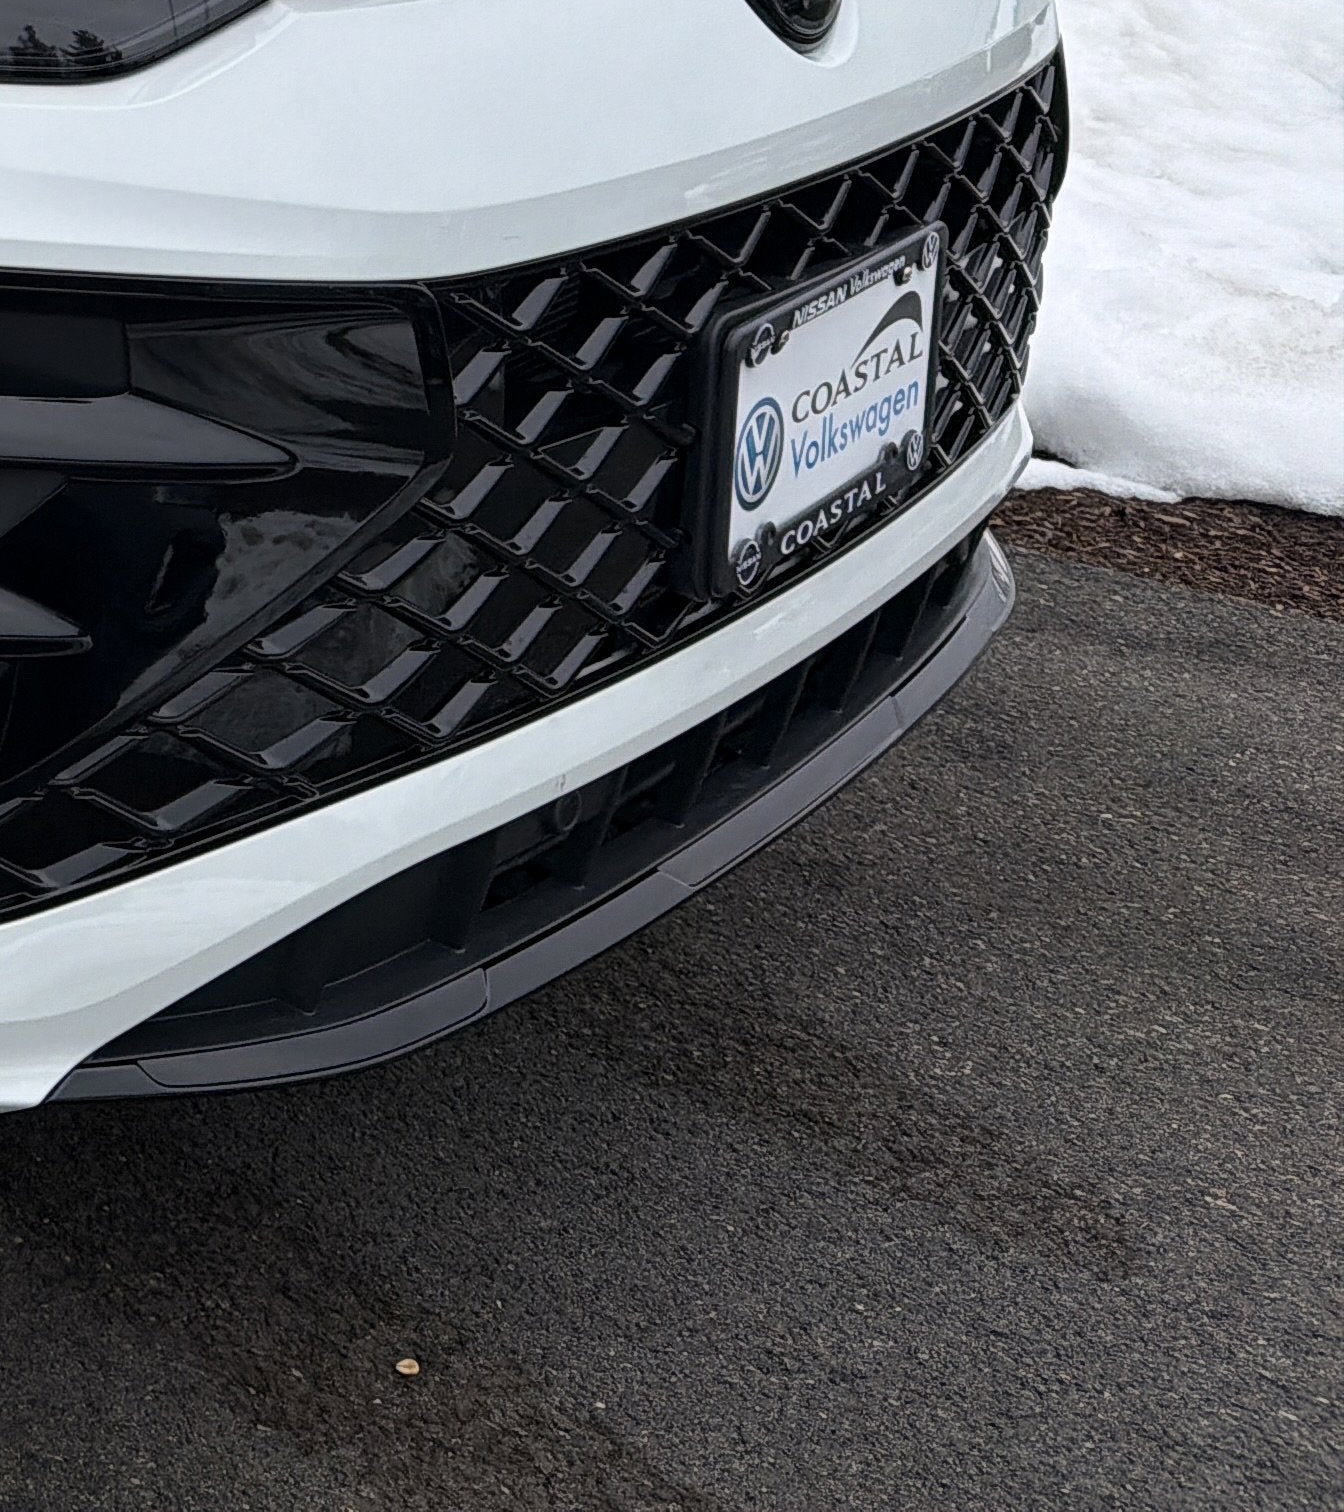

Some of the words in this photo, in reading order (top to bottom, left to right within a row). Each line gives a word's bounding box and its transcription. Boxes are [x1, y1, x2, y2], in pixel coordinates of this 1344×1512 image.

[792, 284, 848, 329] NISSAN
[791, 333, 924, 424] COASTAL
[737, 403, 782, 507] VW
[790, 380, 919, 479] Volkswagen
[780, 472, 887, 555] COASTAL
